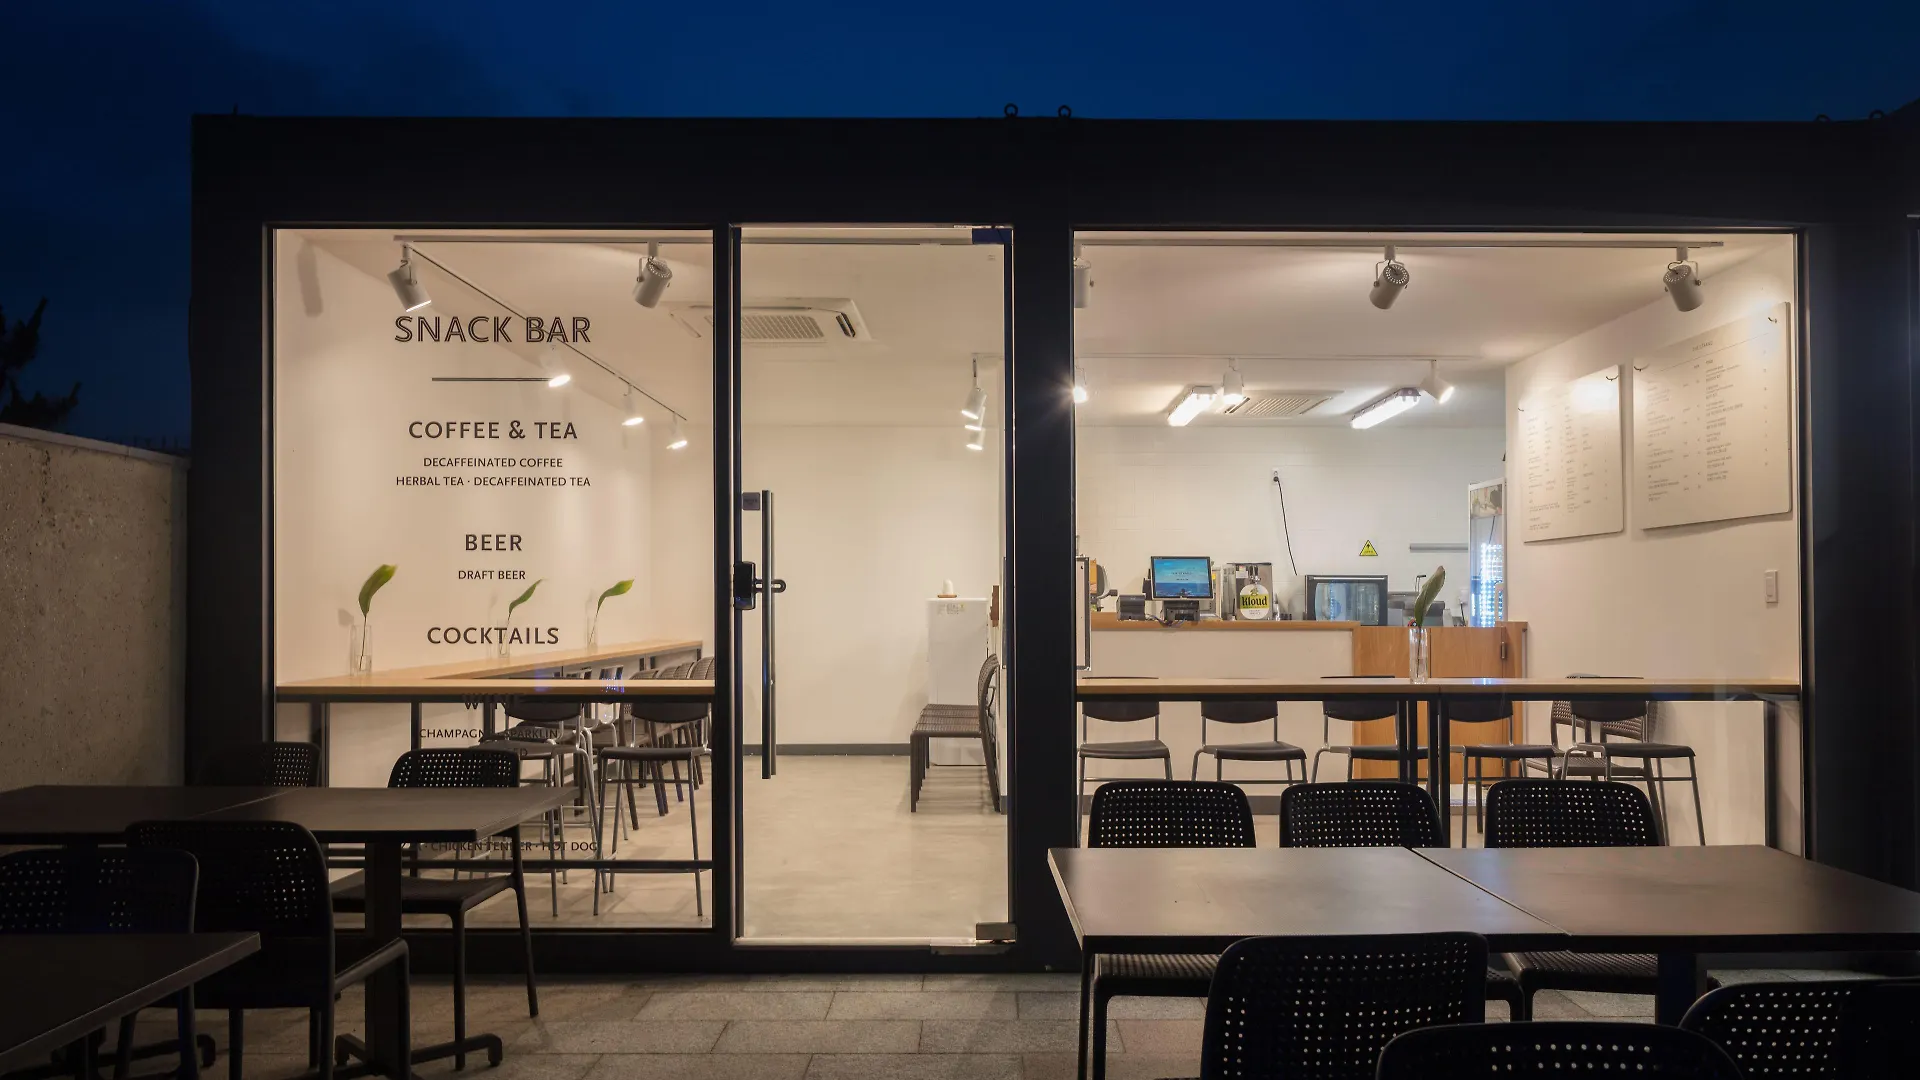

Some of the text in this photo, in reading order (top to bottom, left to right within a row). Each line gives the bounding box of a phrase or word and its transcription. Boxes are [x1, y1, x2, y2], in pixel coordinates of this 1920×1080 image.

[395, 316, 591, 342] SNACK BAR
[408, 420, 577, 439] COFFEE & TEA
[423, 458, 563, 467] DECAFFEINATED COFFEE
[396, 476, 591, 486] HERBAL TEA DECAFFEINATED TEA
[465, 534, 522, 551] BEER
[458, 570, 526, 580] DRAFT BEER
[1242, 596, 1267, 606] Kloud
[427, 627, 559, 644] COCKTAILS
[420, 728, 560, 739] CHAMPAGN SPARKLIN
[485, 841, 532, 851] TENER
